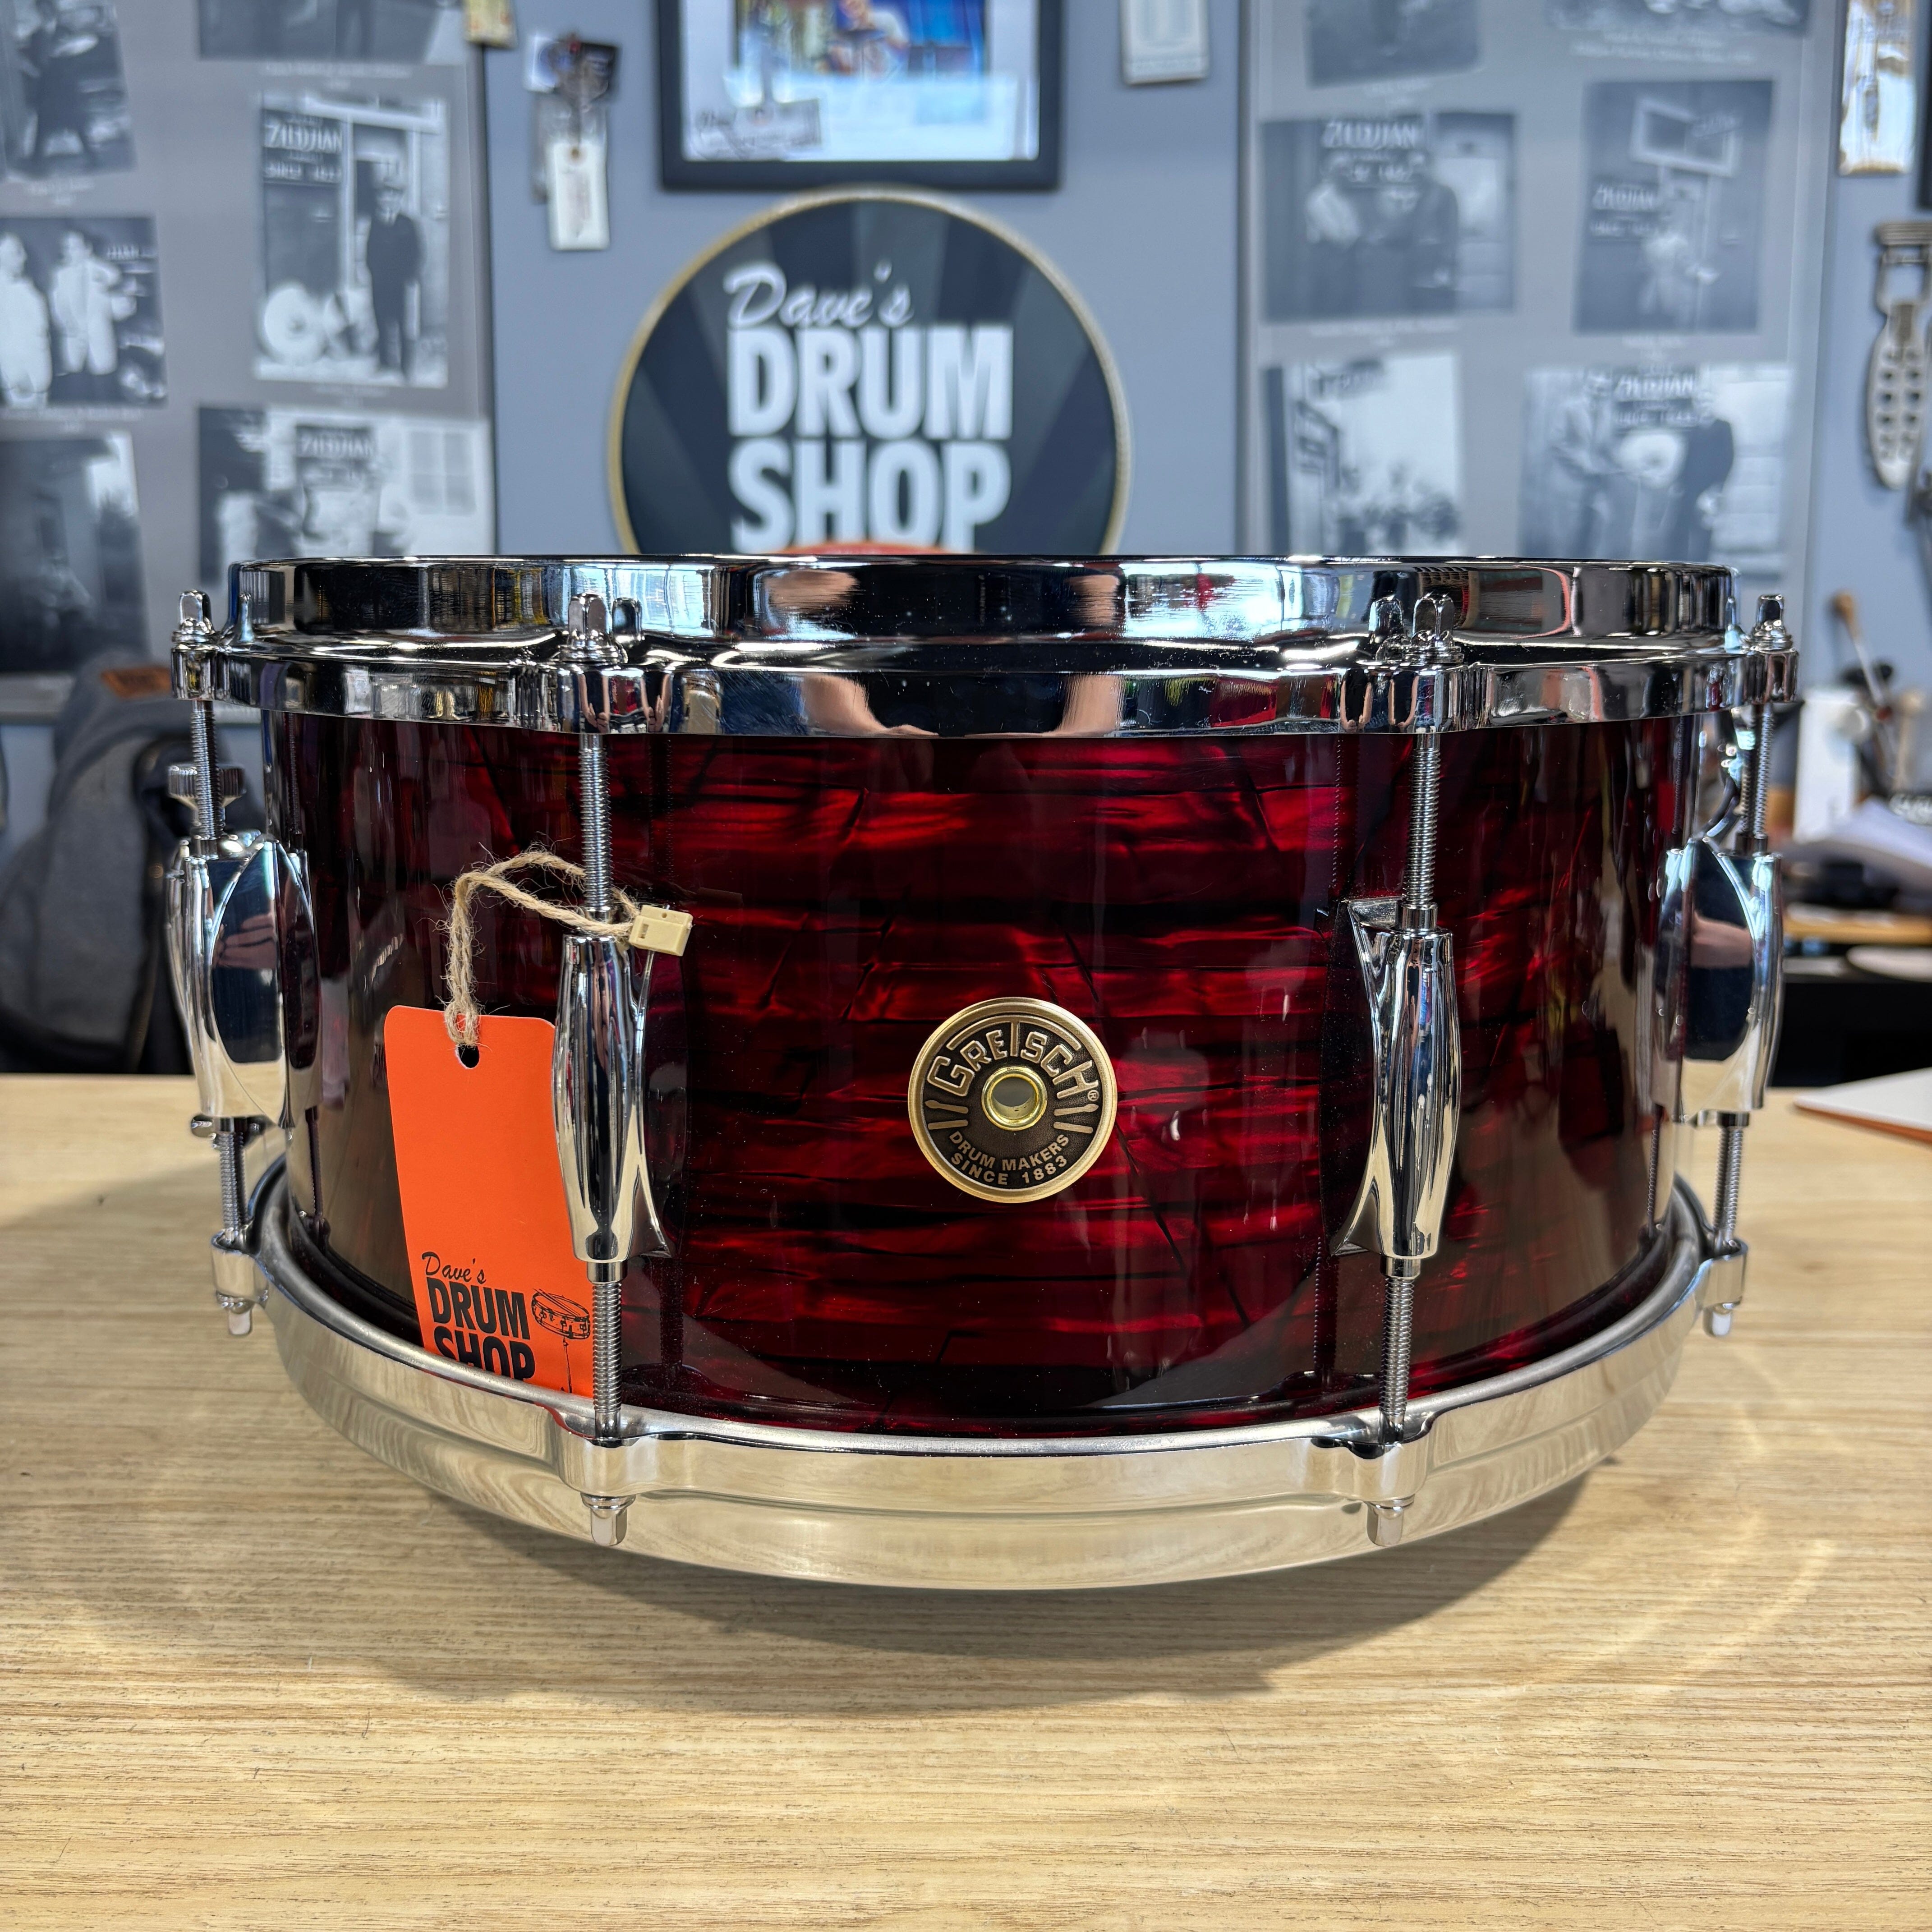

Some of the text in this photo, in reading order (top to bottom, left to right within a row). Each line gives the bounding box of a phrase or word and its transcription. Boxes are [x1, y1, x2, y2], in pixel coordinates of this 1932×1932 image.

[723, 260, 914, 327] Dave's
[727, 324, 1013, 439] DRUM
[727, 435, 1012, 554] SHOP
[949, 1131, 1069, 1171] DRUM MAKERS
[951, 1152, 1067, 1185] SINCE 1883
[422, 1251, 487, 1284] Dave's
[427, 1277, 531, 1340] DRUM
[434, 1326, 536, 1382] SHOP
